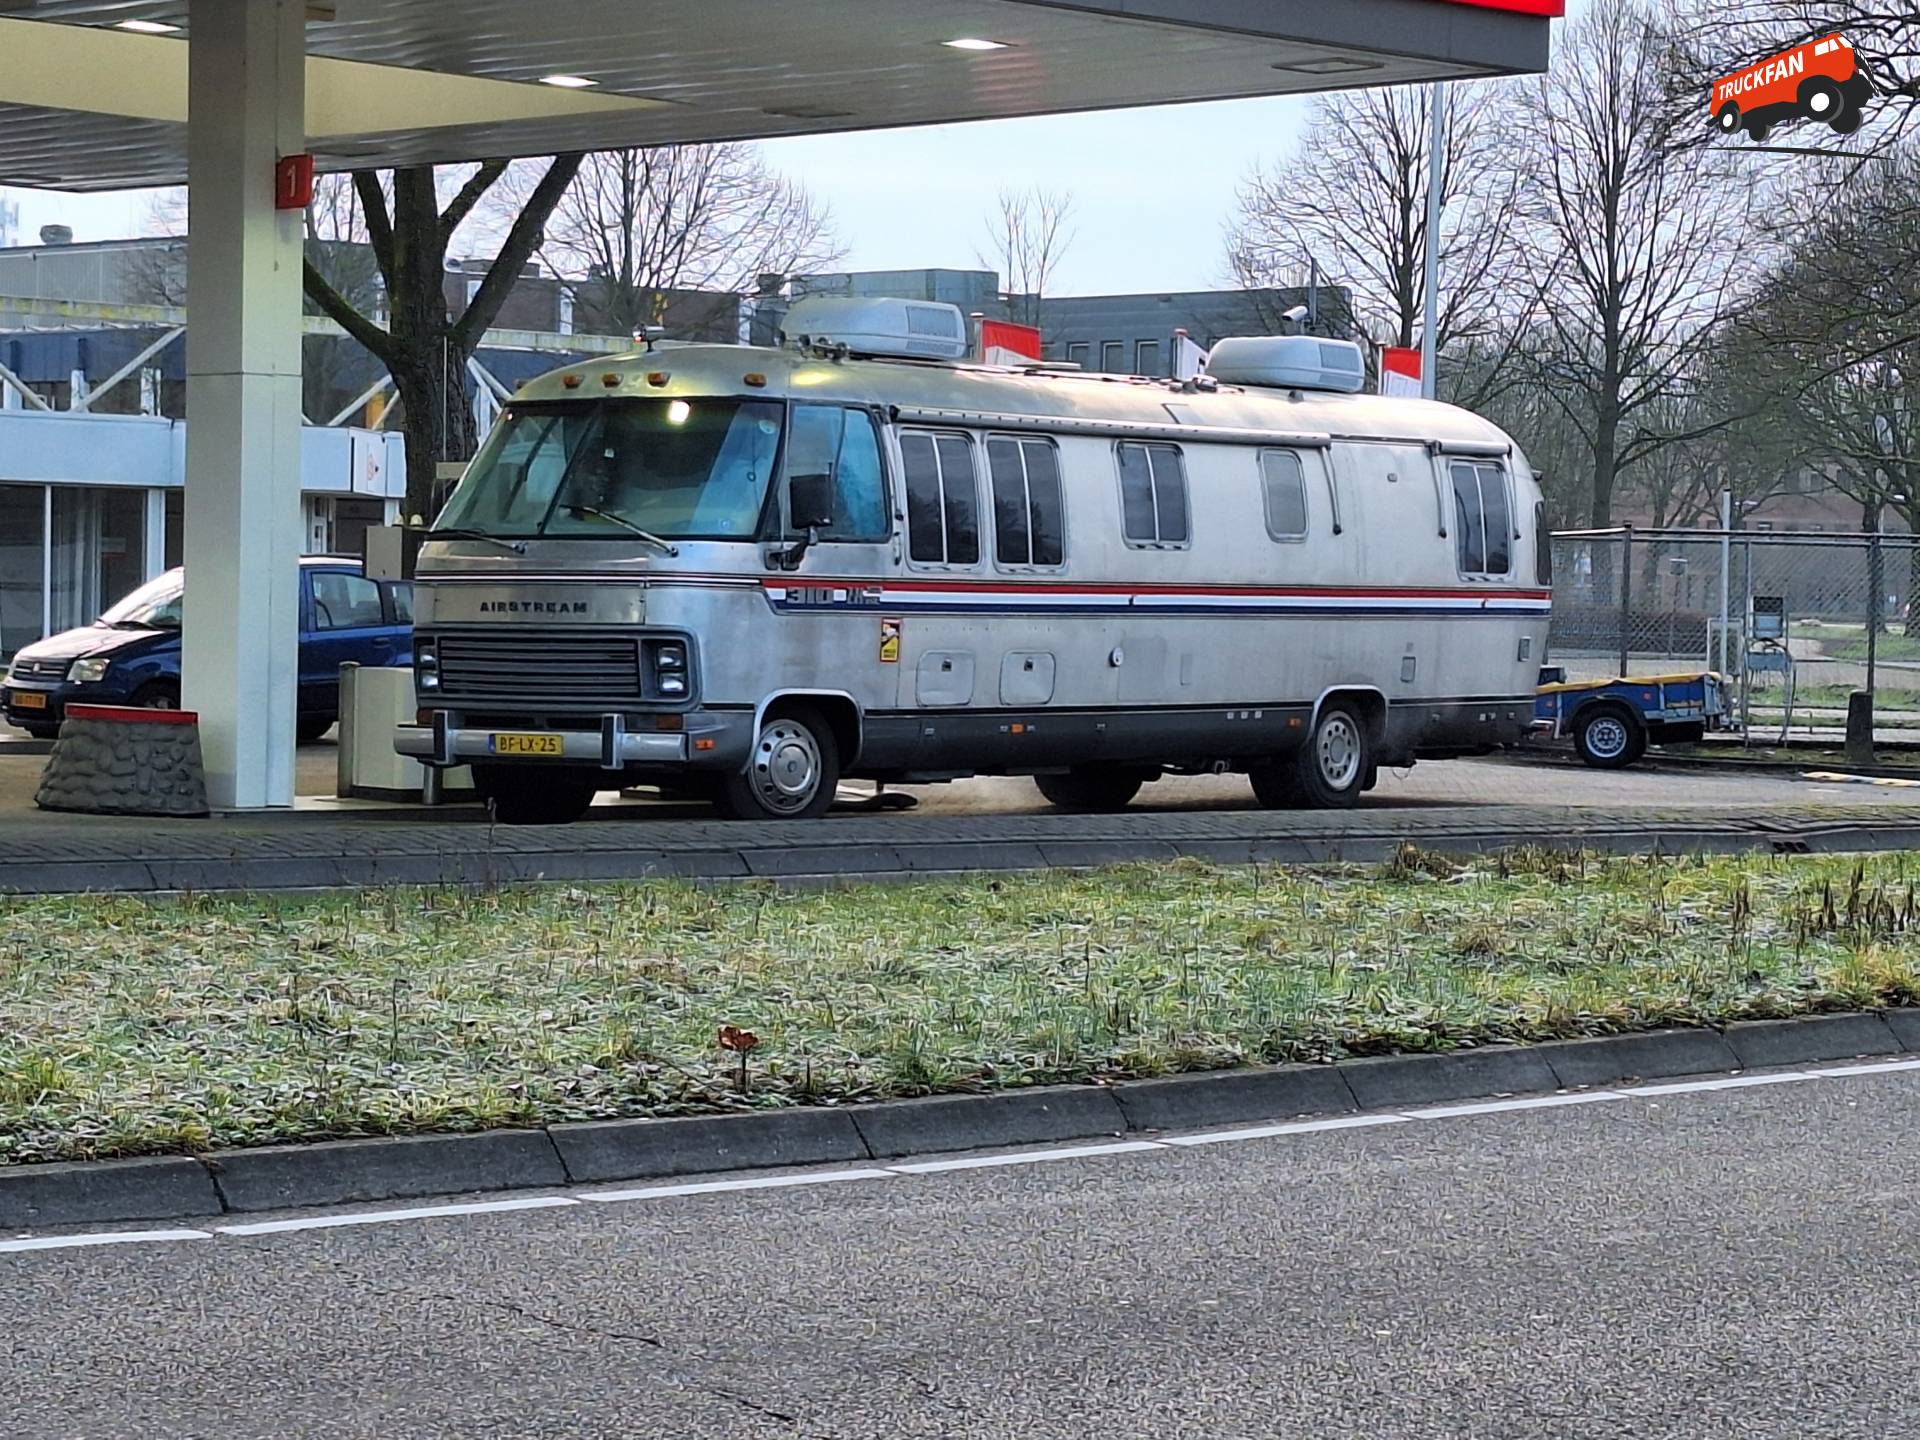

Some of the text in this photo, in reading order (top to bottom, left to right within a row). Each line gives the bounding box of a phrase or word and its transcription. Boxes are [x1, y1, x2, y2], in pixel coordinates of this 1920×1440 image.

[287, 164, 296, 198] 1
[480, 601, 587, 613] AIRSTREAM
[500, 736, 556, 752] BF-LX-25
